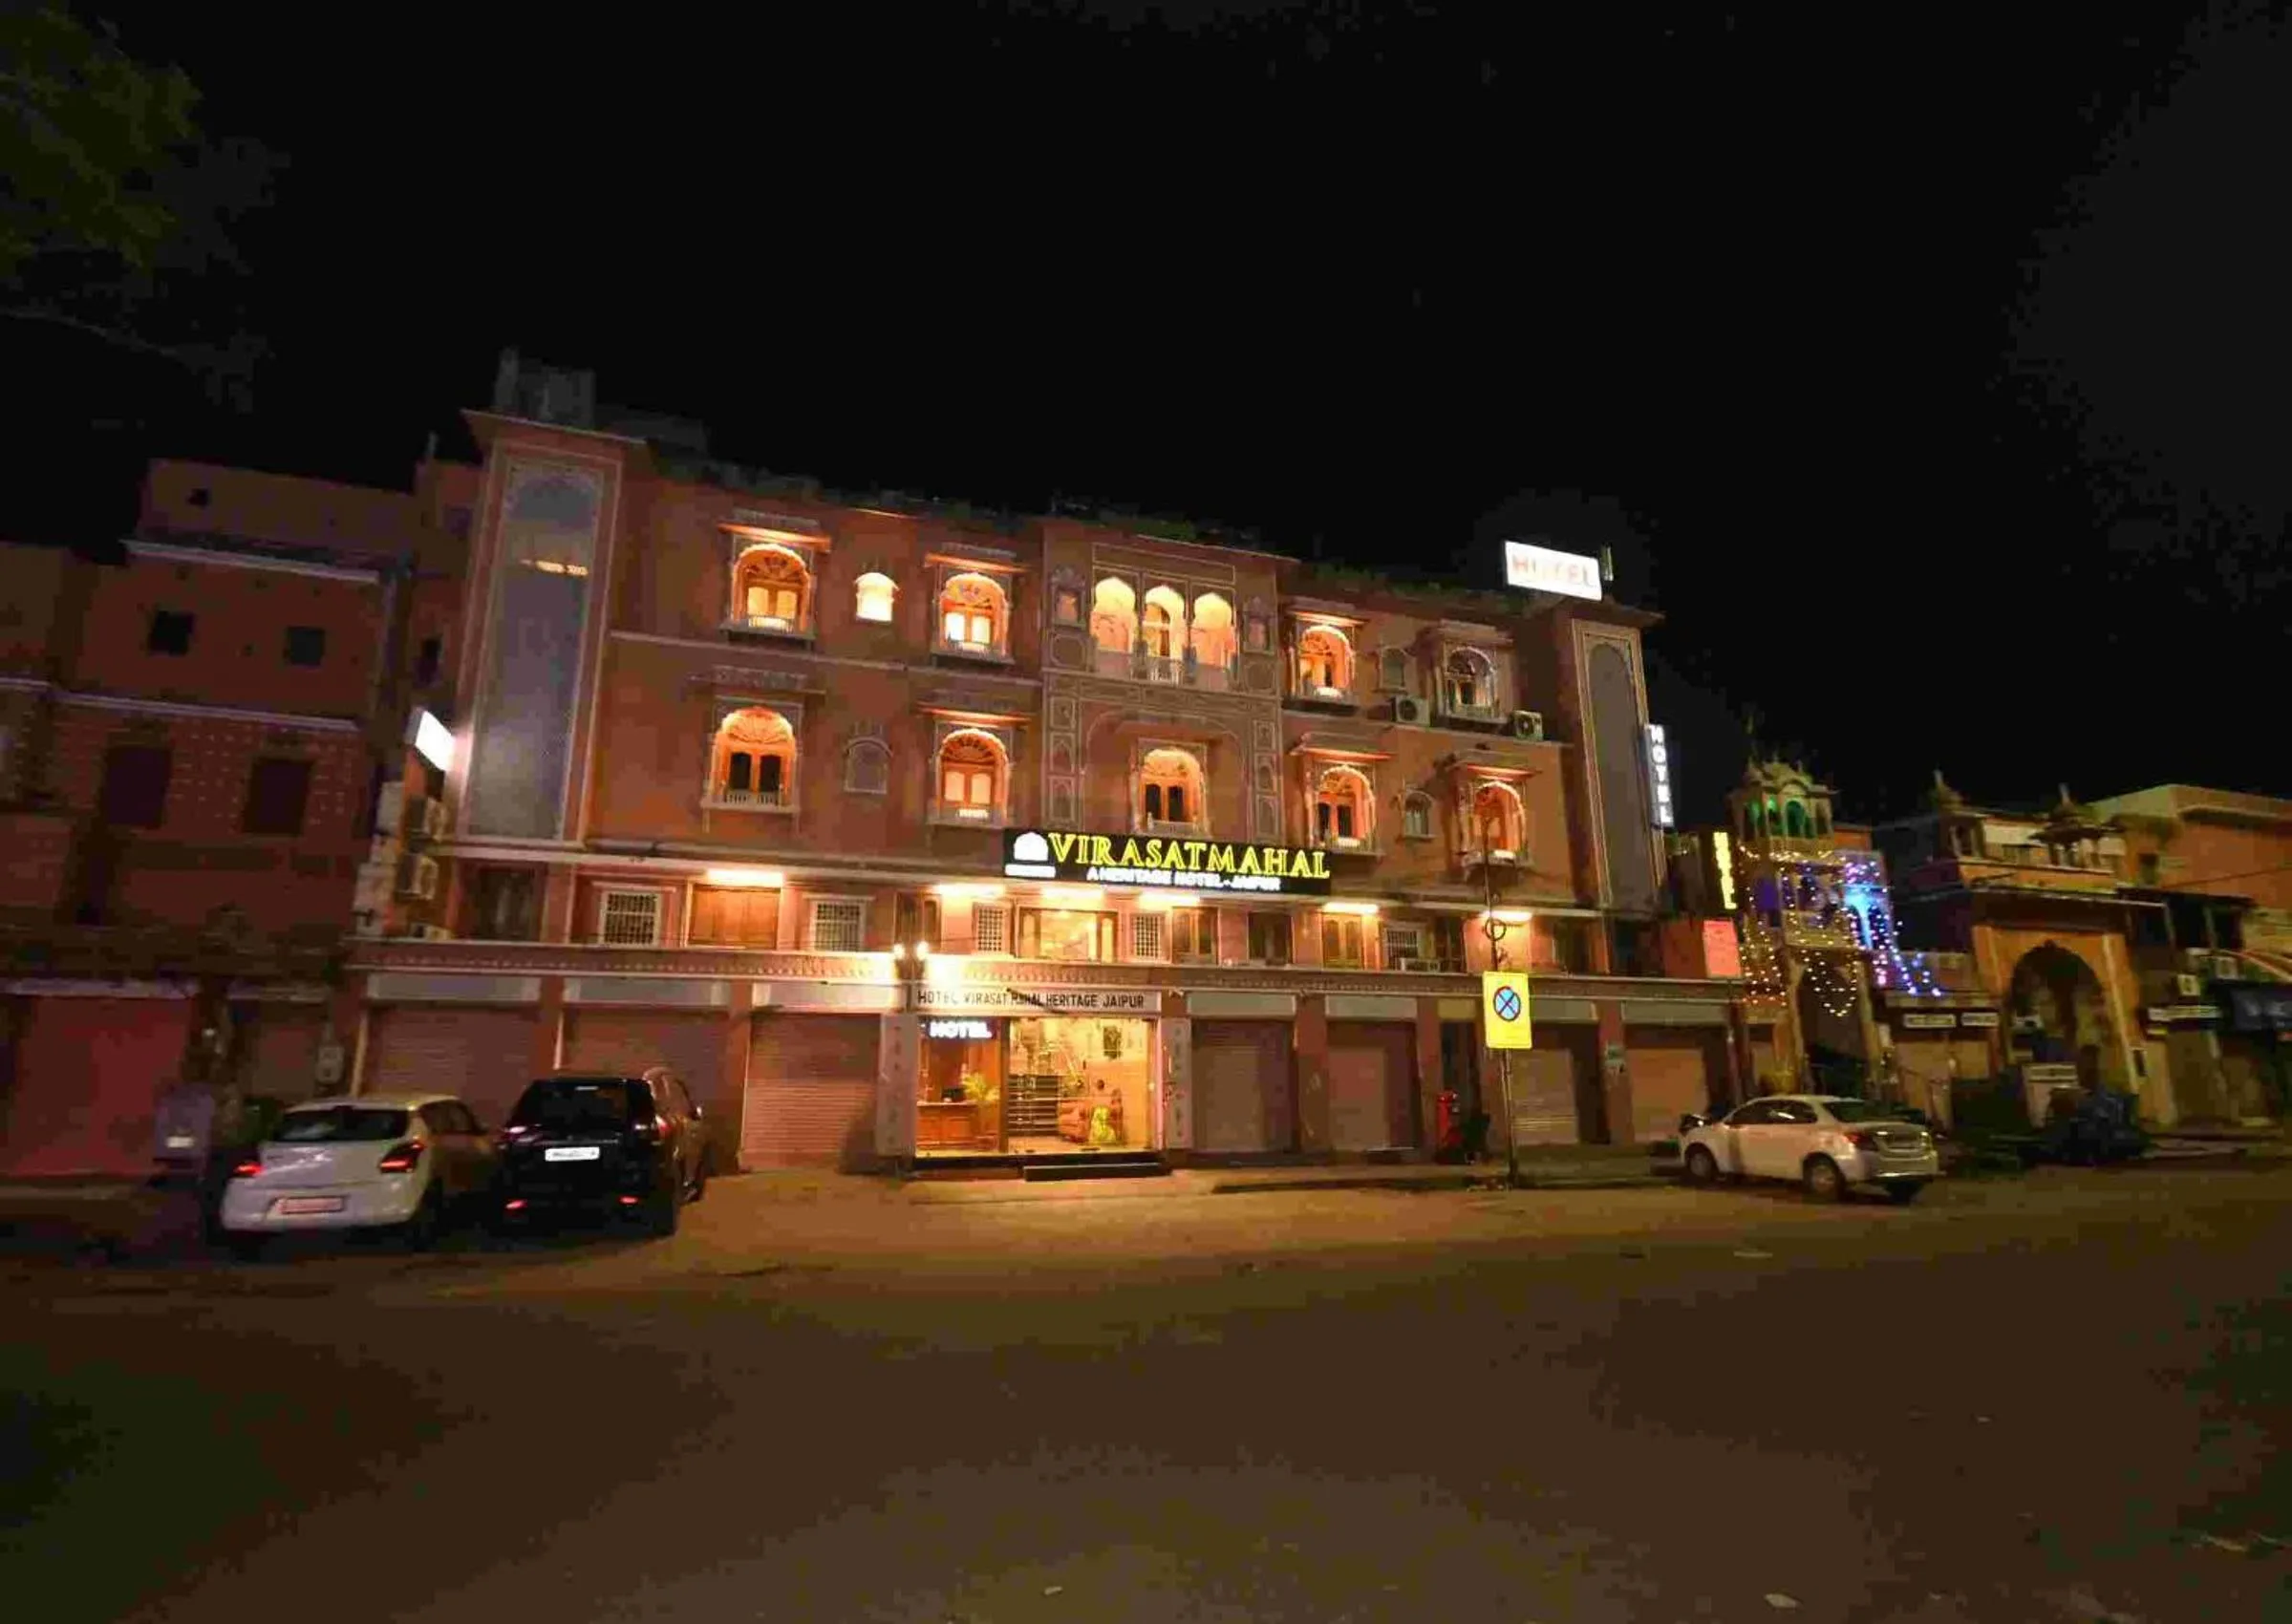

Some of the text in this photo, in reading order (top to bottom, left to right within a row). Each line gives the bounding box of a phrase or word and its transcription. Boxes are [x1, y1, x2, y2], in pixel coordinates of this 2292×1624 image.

[1650, 725, 1673, 823] HOTEL
[917, 989, 960, 1005] HOTEL
[962, 991, 1008, 1007] VIRASAT
[1046, 993, 1098, 1008] HERITAGE
[1103, 994, 1146, 1009] JAIPUR
[930, 1021, 993, 1038] HOTEL
